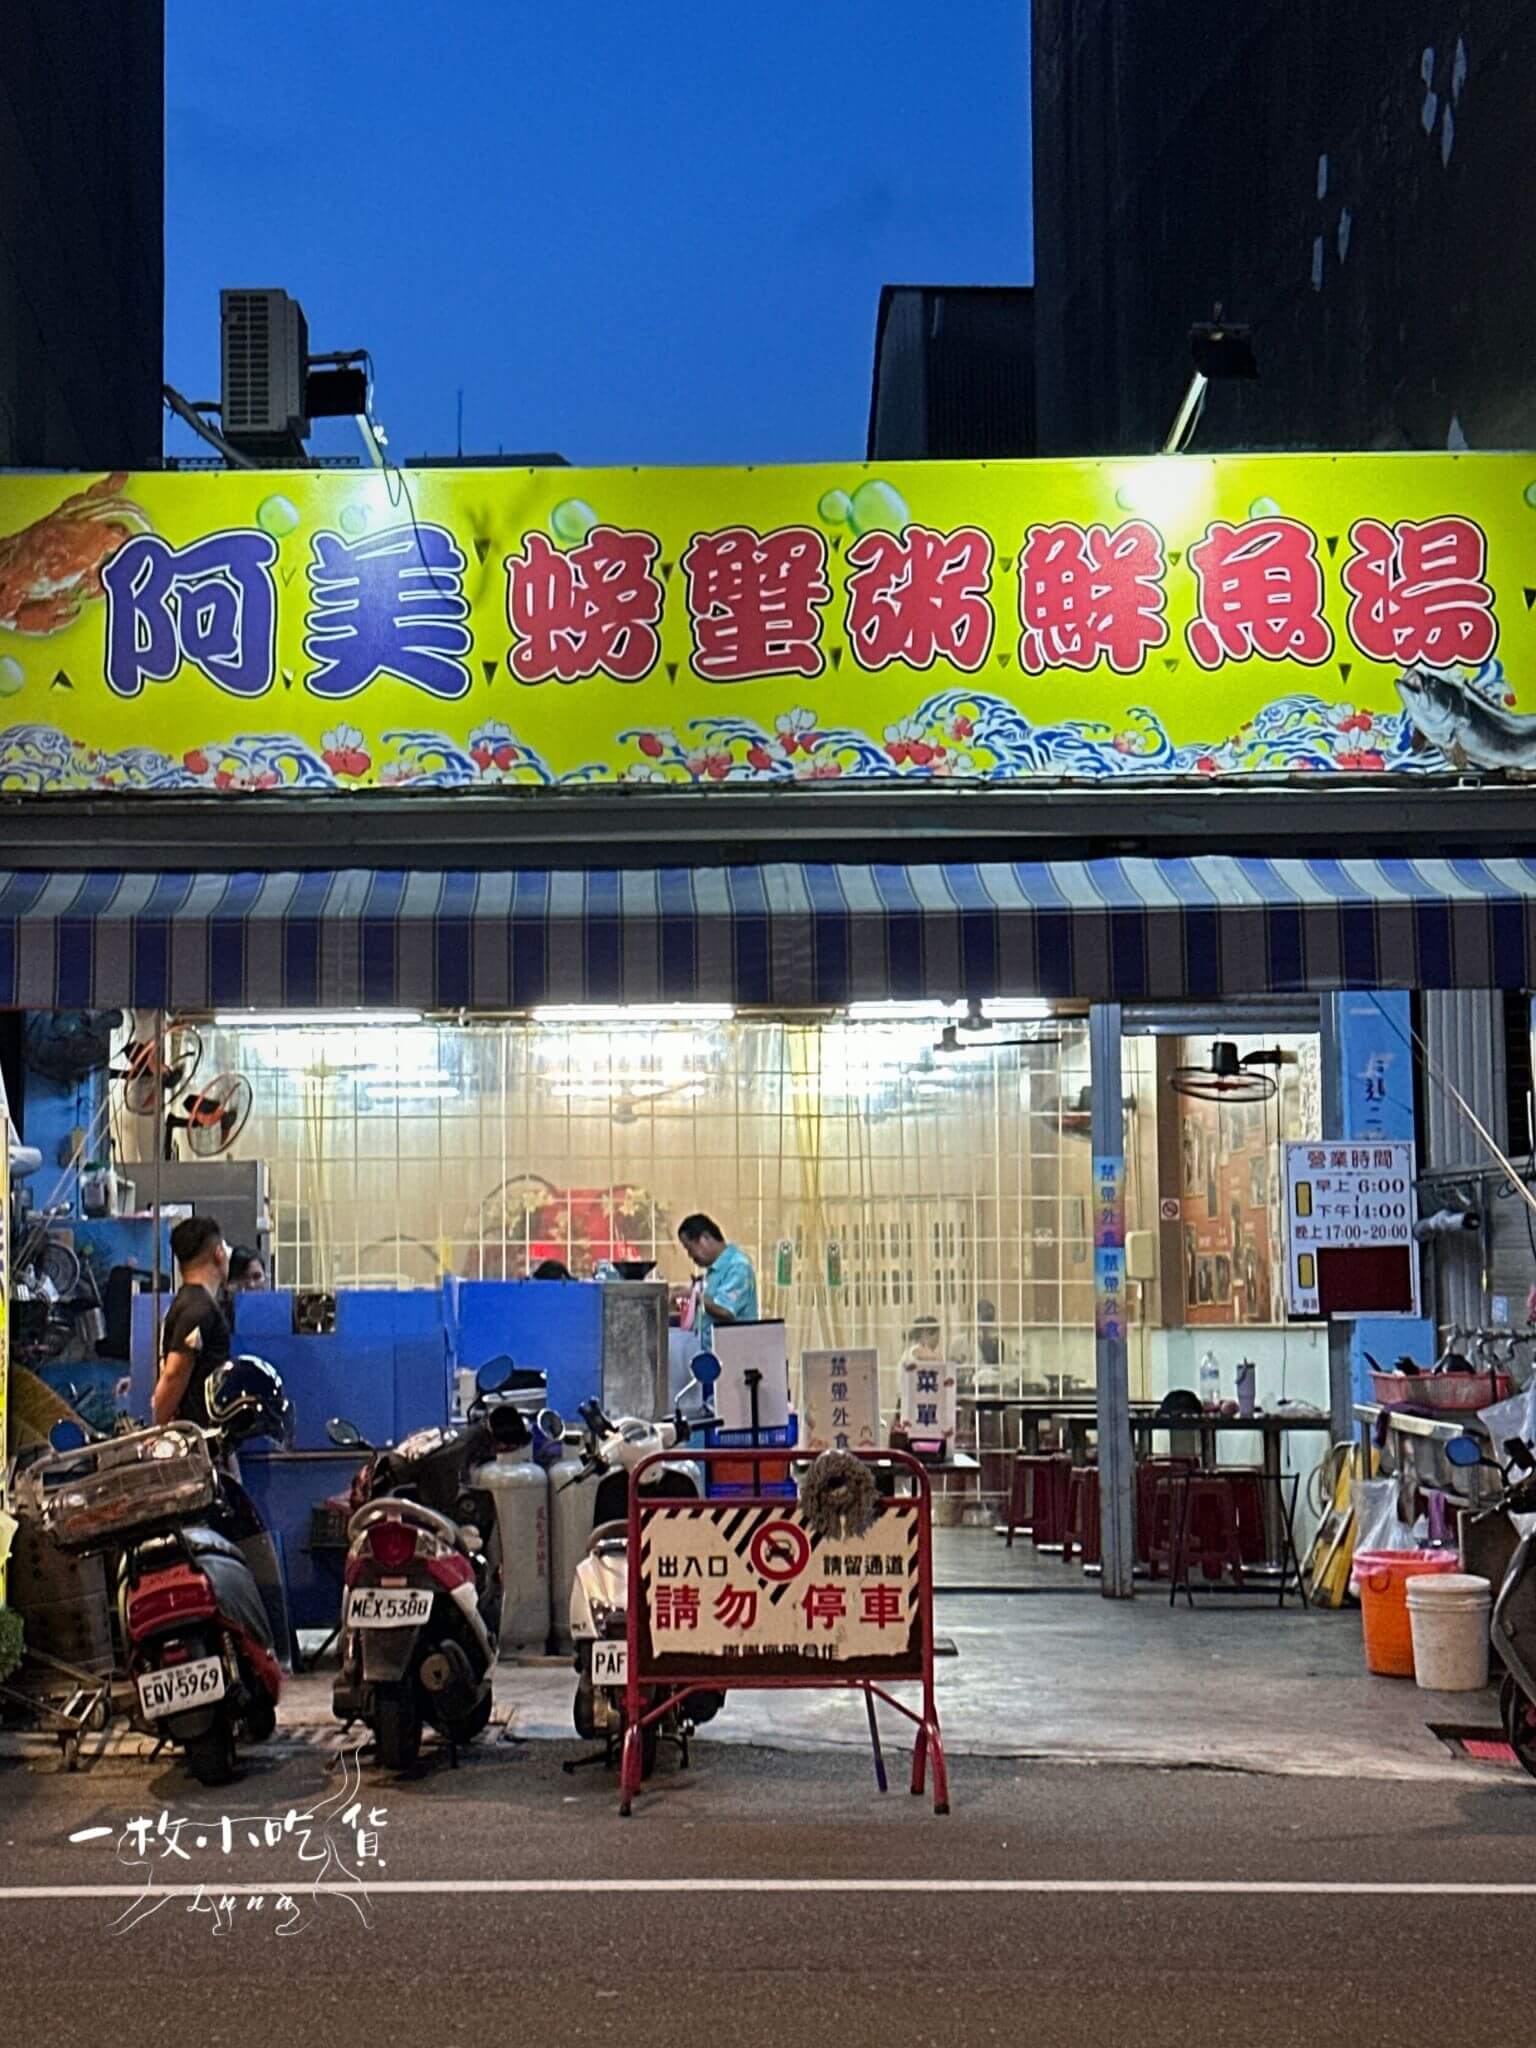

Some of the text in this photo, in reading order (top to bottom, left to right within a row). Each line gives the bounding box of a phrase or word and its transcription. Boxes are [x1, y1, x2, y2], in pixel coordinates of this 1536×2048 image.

[1307, 1150, 1393, 1169] 營業時間
[1358, 1179, 1405, 1194] 6:00
[916, 1370, 938, 1427] 菜單
[658, 1556, 729, 1578] 出入口
[823, 1555, 904, 1577] 請留通道
